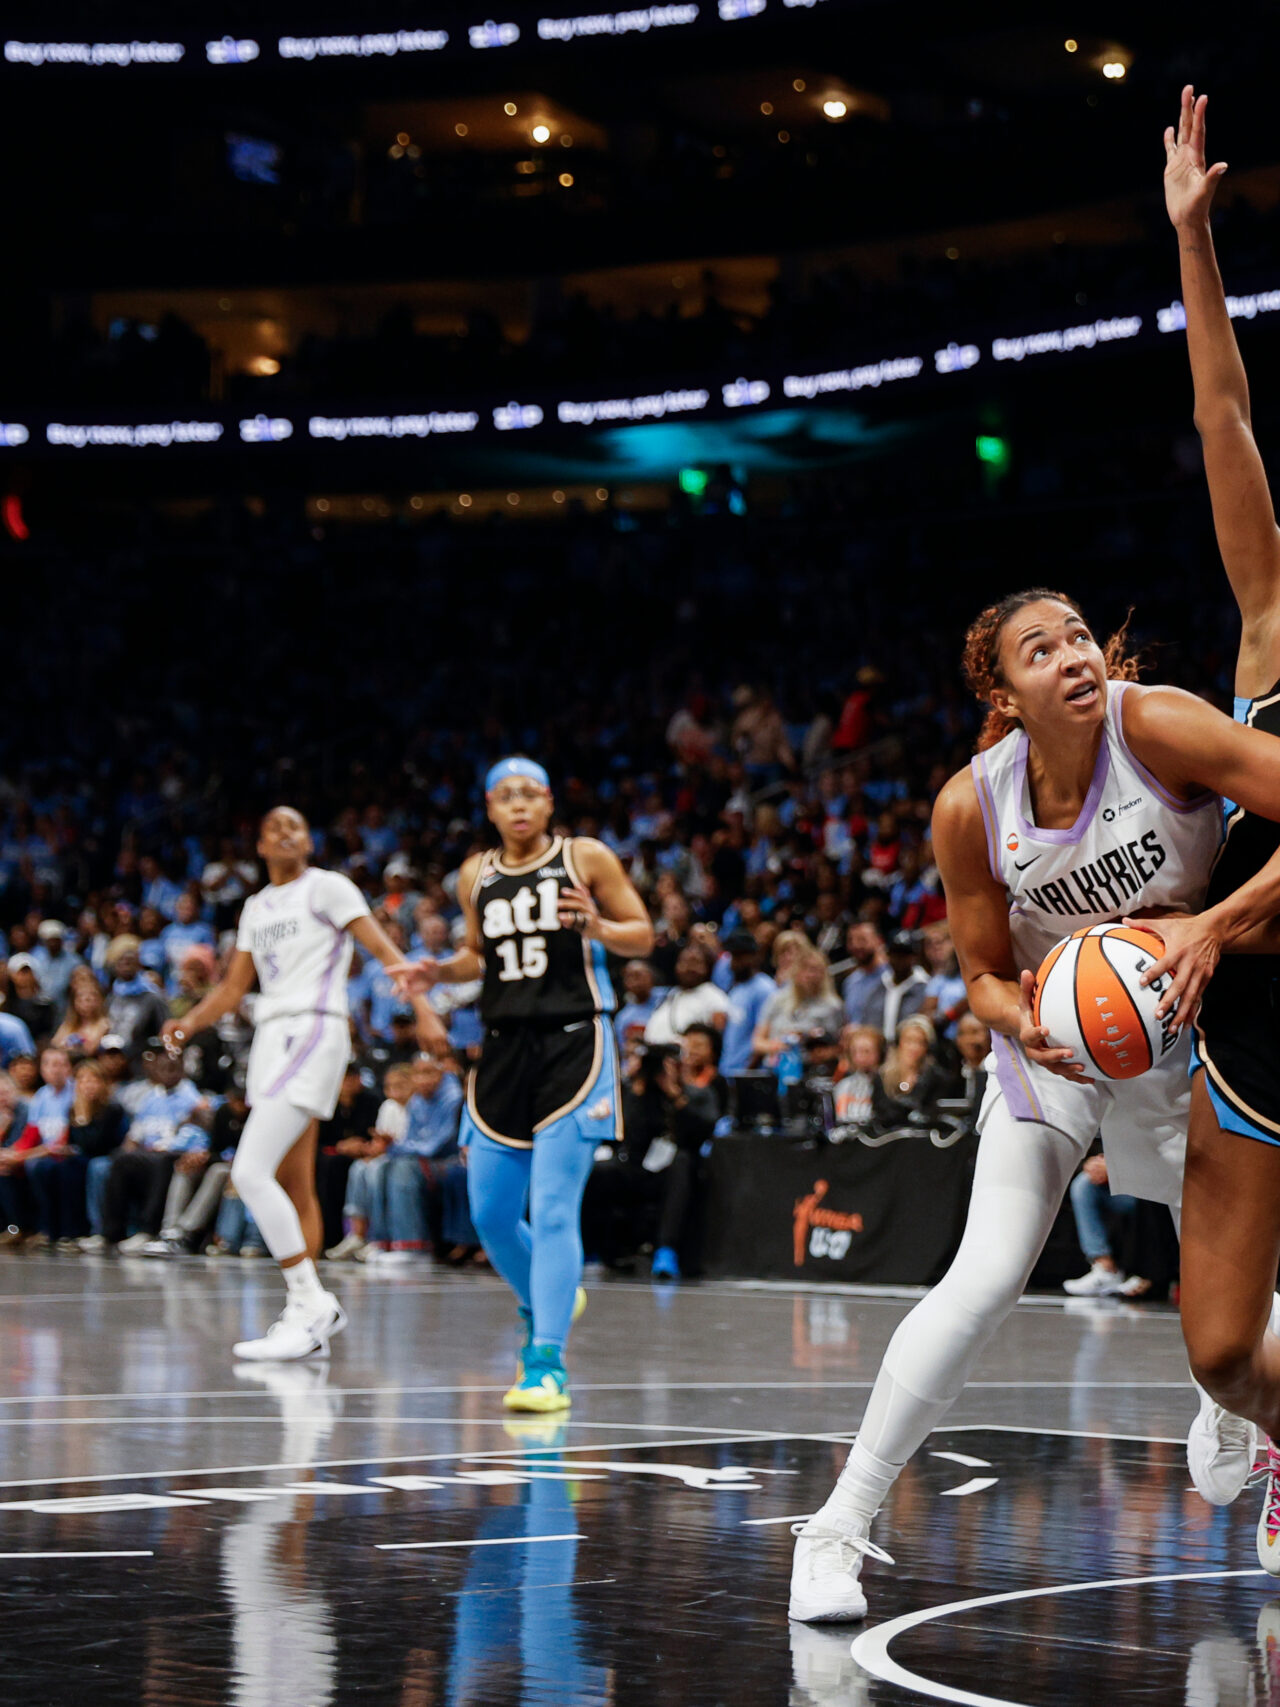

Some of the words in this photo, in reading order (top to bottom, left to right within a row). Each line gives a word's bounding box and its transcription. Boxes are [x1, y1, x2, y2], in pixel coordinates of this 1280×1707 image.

[1024, 829, 1167, 916] VALKYRIES
[483, 878, 562, 938] atl
[495, 936, 549, 982] 15
